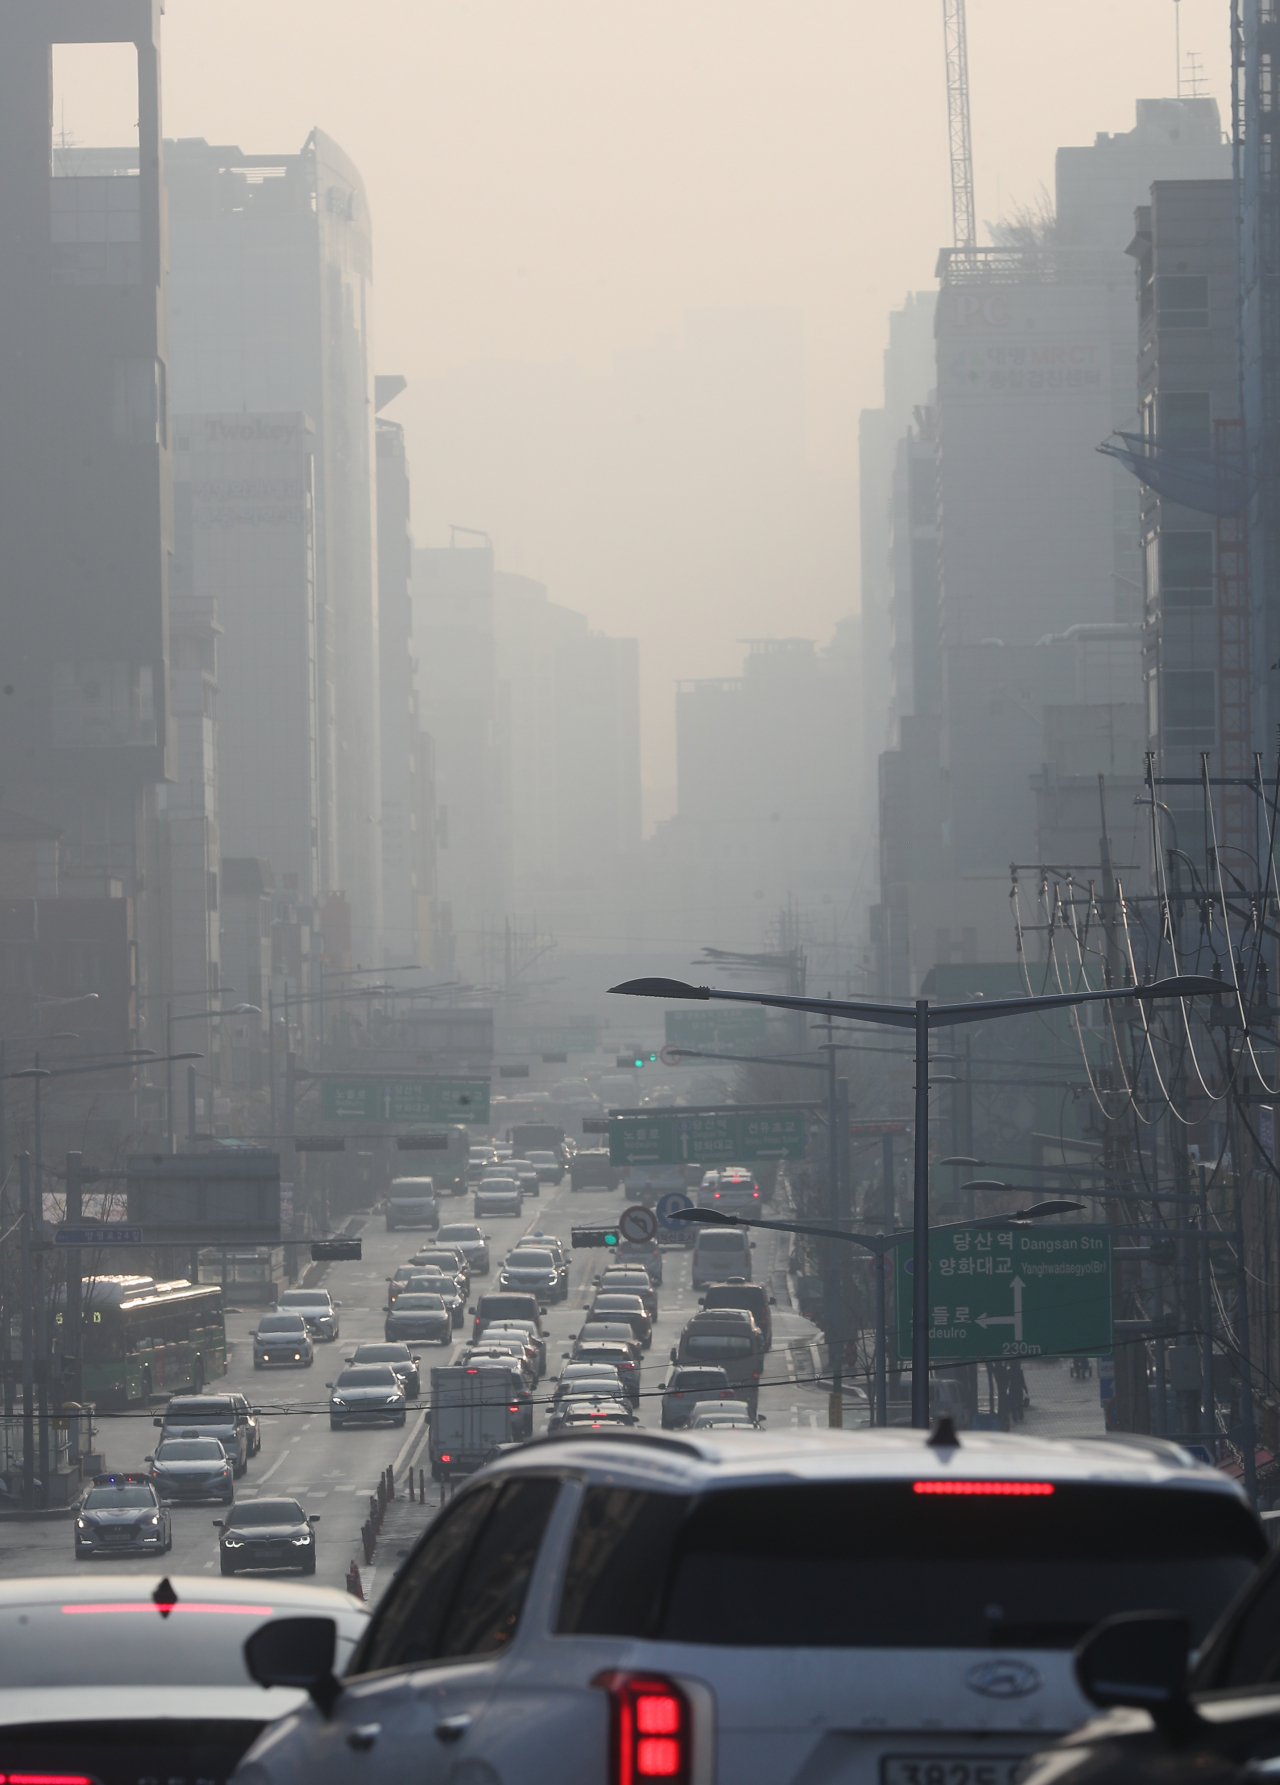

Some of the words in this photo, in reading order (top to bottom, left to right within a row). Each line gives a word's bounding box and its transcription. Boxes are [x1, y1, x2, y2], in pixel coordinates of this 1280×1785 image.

[954, 294, 1009, 327] PC
[205, 418, 297, 445] Twokey
[441, 1090, 482, 1101] 선유교
[693, 1119, 727, 1131] 당산역
[693, 1139, 734, 1151] 양화대교
[953, 1231, 1014, 1252] 당산역
[1021, 1237, 1078, 1253] Dangsan
[1080, 1236, 1103, 1250] Stn
[939, 1256, 1013, 1276] 양화대교
[1021, 1260, 1107, 1278] Yanghwadaegyo(Br)
[911, 1327, 967, 1339] deulro
[1002, 1342, 1042, 1355] 230m
